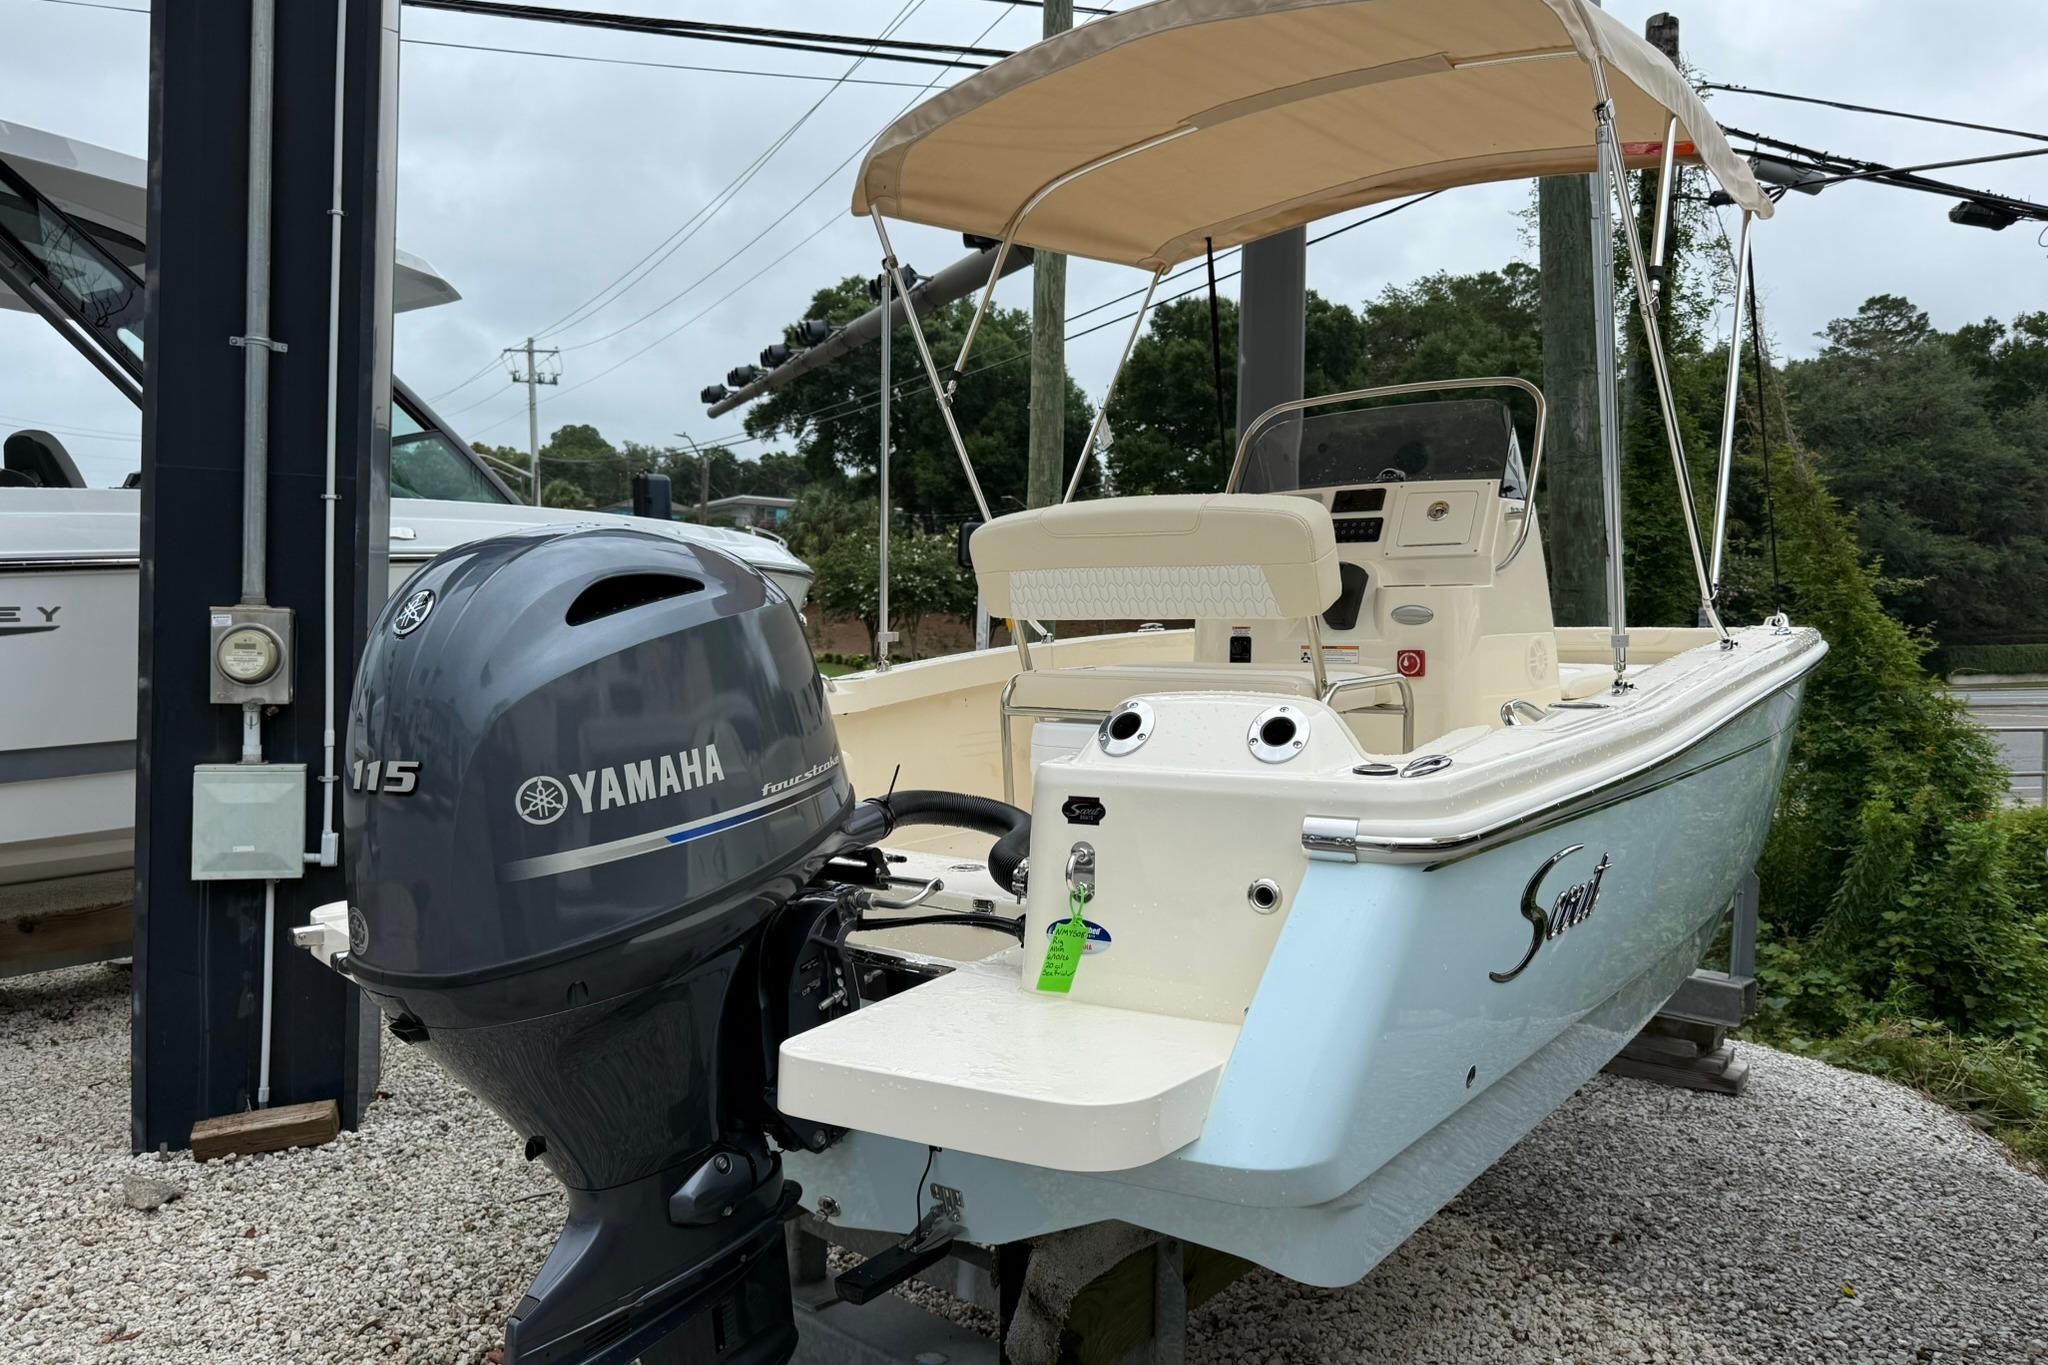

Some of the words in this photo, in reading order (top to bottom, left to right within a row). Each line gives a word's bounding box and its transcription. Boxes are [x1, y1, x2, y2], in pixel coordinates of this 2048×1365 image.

[353, 759, 420, 793] 115
[568, 743, 725, 814] YAMAHA
[761, 774, 802, 796] four
[1064, 802, 1104, 817] Scout
[1489, 842, 1613, 983] Scout
